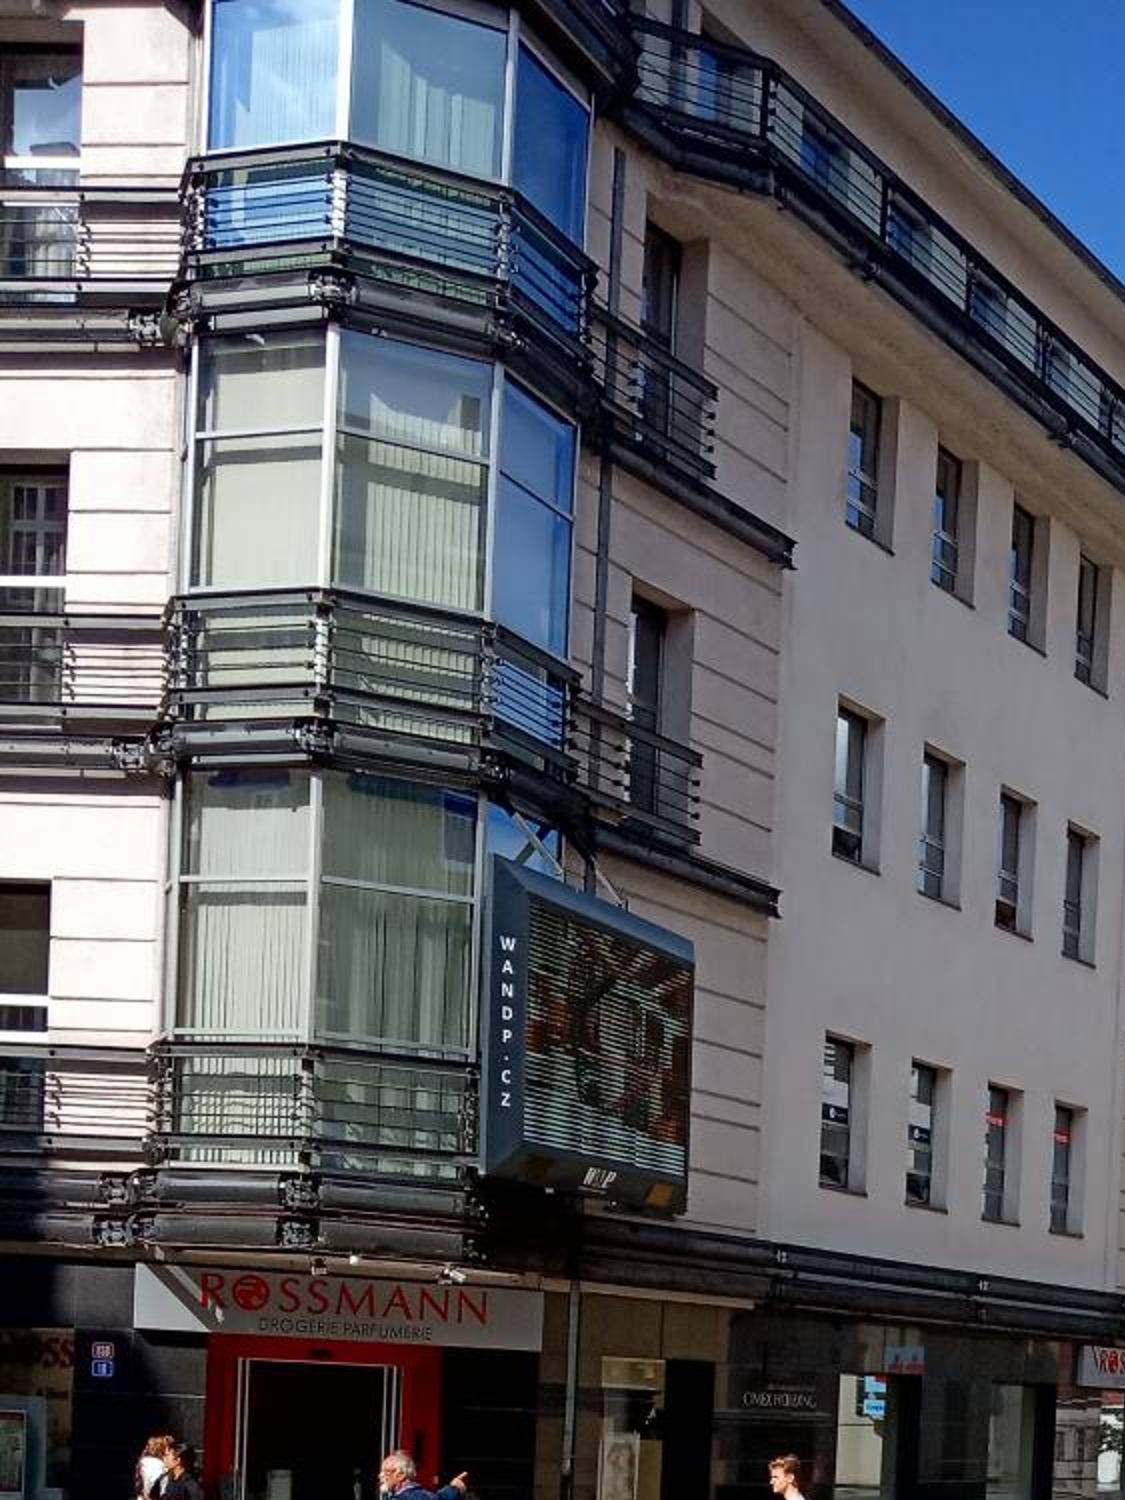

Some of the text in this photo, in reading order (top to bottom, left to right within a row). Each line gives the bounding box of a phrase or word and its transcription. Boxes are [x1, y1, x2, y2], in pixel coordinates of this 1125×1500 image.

[498, 936, 517, 1108] WANDP.CZ
[198, 1272, 488, 1325] ROSSMANN
[258, 1316, 433, 1342] DROGERIE PARFUMERIE
